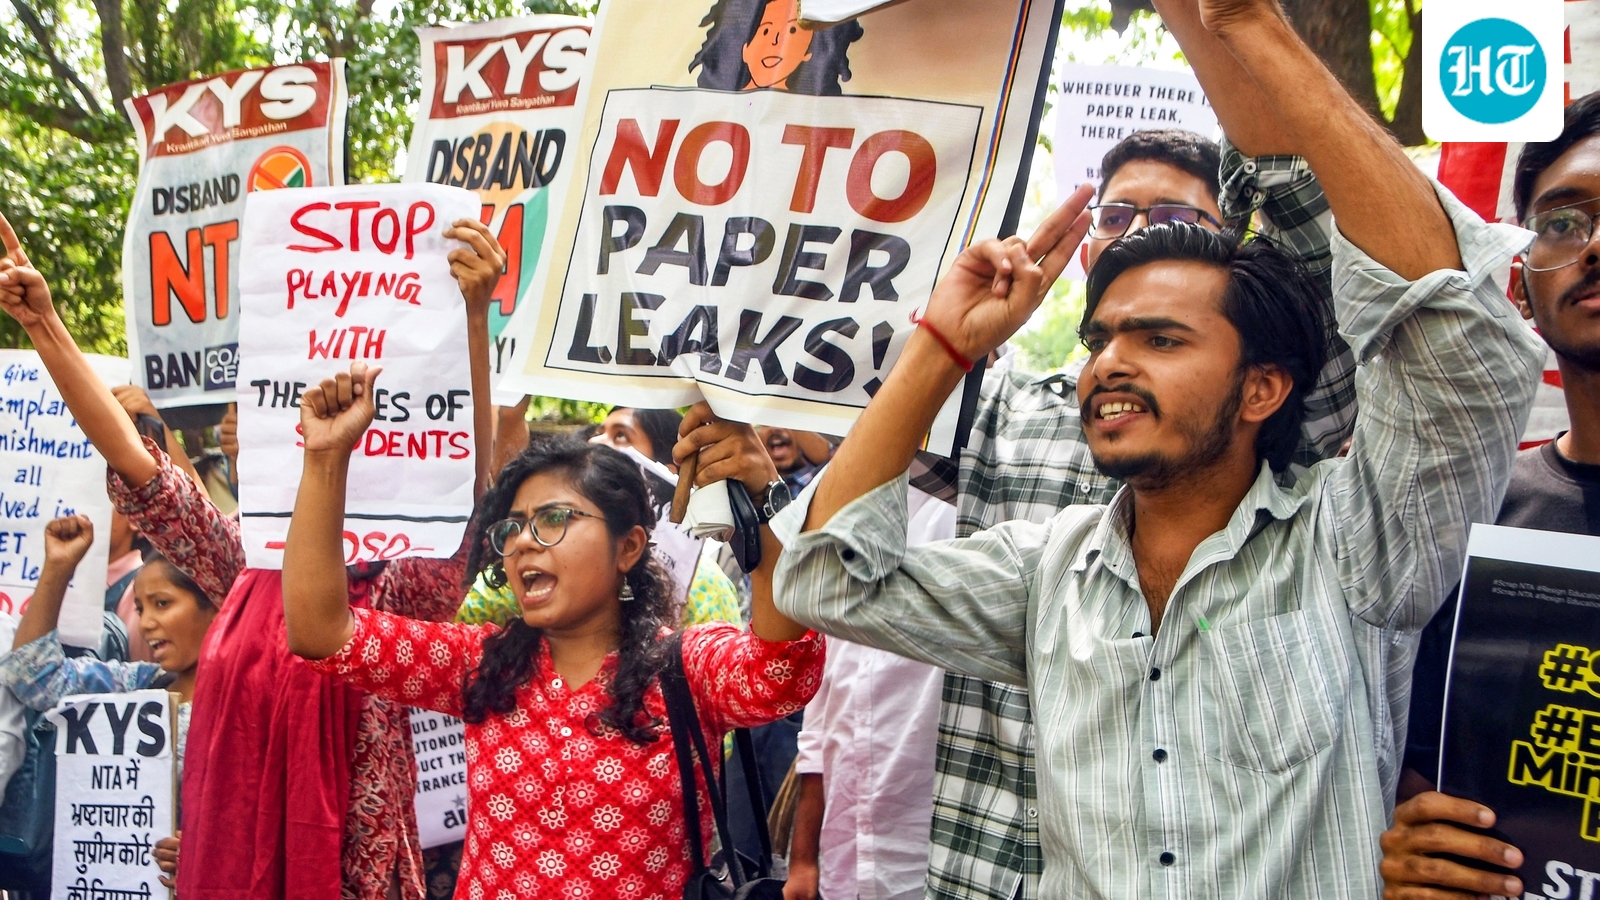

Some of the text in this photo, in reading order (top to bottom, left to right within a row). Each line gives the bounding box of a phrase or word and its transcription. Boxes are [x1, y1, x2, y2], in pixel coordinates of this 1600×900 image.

[443, 28, 591, 104] KYS
[147, 66, 317, 144] KYS
[1063, 82, 1142, 98] WHEREVER
[1149, 86, 1196, 104] THERE
[1081, 125, 1125, 140] THERE
[1087, 104, 1182, 124] PAPER LEAK,
[426, 128, 566, 191] DISBAND
[599, 118, 937, 223] NO TO
[152, 173, 240, 216] DISBAND
[286, 201, 435, 260] STOP
[149, 219, 240, 326] NT
[597, 205, 911, 303] PAPER
[286, 269, 422, 318] PLAYING
[308, 327, 386, 360] WITH
[568, 292, 895, 399] LEAKS!
[4, 364, 39, 386] Give
[145, 352, 201, 391] BAN
[0, 389, 77, 430] mplar
[250, 379, 307, 408] THE
[425, 390, 471, 421] OF
[14, 465, 42, 487] all
[60, 702, 165, 757] KYS
[92, 758, 141, 790] NTA में
[417, 756, 443, 772] UCT
[71, 795, 155, 828] भ्रष्टाचार की
[73, 831, 152, 874] सुप्रीम कोर्ट
